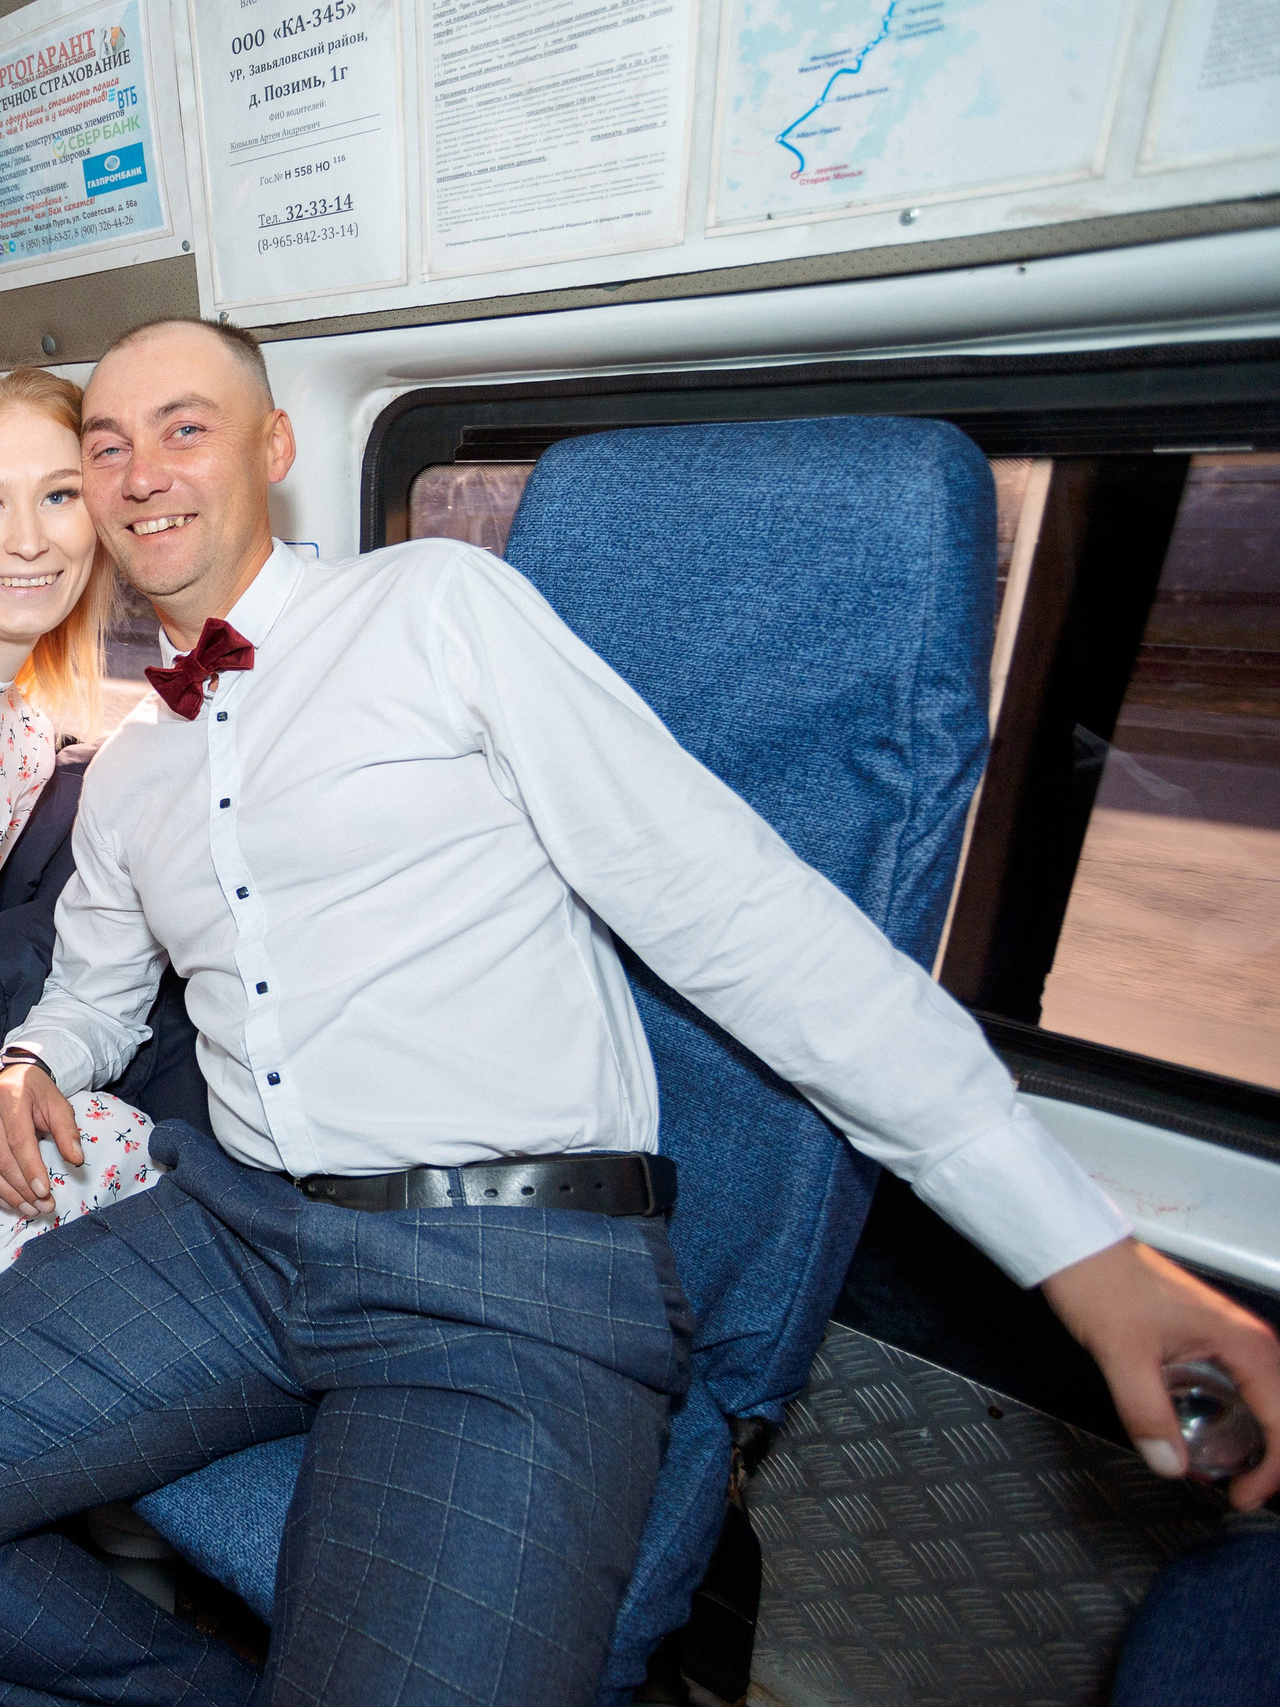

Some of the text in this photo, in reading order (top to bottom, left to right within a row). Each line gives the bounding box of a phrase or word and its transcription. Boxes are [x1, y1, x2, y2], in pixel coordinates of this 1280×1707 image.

[231, 0, 357, 55] ООО «КА-345»
[453, 11, 478, 22] каждого
[478, 3, 505, 15] ребенка,
[566, 22, 618, 40] предварительно
[621, 14, 645, 25] подать
[470, 39, 499, 52] бесплатно
[534, 21, 555, 33] ручной
[574, 7, 607, 20] размером
[11, 50, 96, 90] СТРАХОВАЯ АКЦИОНЕРНАЯ КОМПАНИЯ
[39, 49, 131, 96] СТРАХОВАНИЕ
[229, 31, 368, 82] УР, Завьяловский район,
[595, 67, 614, 76] более
[5, 105, 47, 129] оформление,
[48, 87, 91, 109] стоимость
[92, 76, 120, 93] полиса
[117, 85, 138, 110] ВТБ
[248, 64, 348, 110] д. Позимь, 1г
[25, 115, 44, 129] банке
[58, 93, 108, 118] конкурентов!
[269, 99, 327, 122] ФИО водителей:
[24, 123, 83, 150] конструктивных
[84, 108, 125, 131] элементов
[68, 114, 141, 151] СБЕР БАНК
[230, 120, 321, 151] Копылов Артем Андреевич
[29, 161, 51, 174] жизни
[58, 147, 91, 167] здоровья
[284, 170, 292, 180] Н
[294, 164, 313, 178] 558
[315, 160, 330, 173] НО
[333, 154, 346, 164] 116
[25, 180, 69, 202] страхование.
[87, 166, 143, 190] ГАЗПРОМБАНК
[0, 215, 33, 230] доступнее,
[48, 206, 62, 217] Вам
[63, 197, 96, 214] кажется!
[22, 196, 63, 216] страхование
[258, 193, 353, 226] Тел. 32-33-14
[10, 228, 27, 241] адрес:
[33, 220, 52, 233] Малая
[52, 217, 72, 230] Пурга,
[72, 214, 81, 225] ул.
[82, 206, 117, 221] Советская,
[25, 237, 41, 252] (950)
[41, 229, 74, 245] 816-63-57,
[80, 224, 98, 239] (900)
[98, 215, 134, 234] 326-44-26
[257, 222, 359, 254] (8-965-842-33-14)
